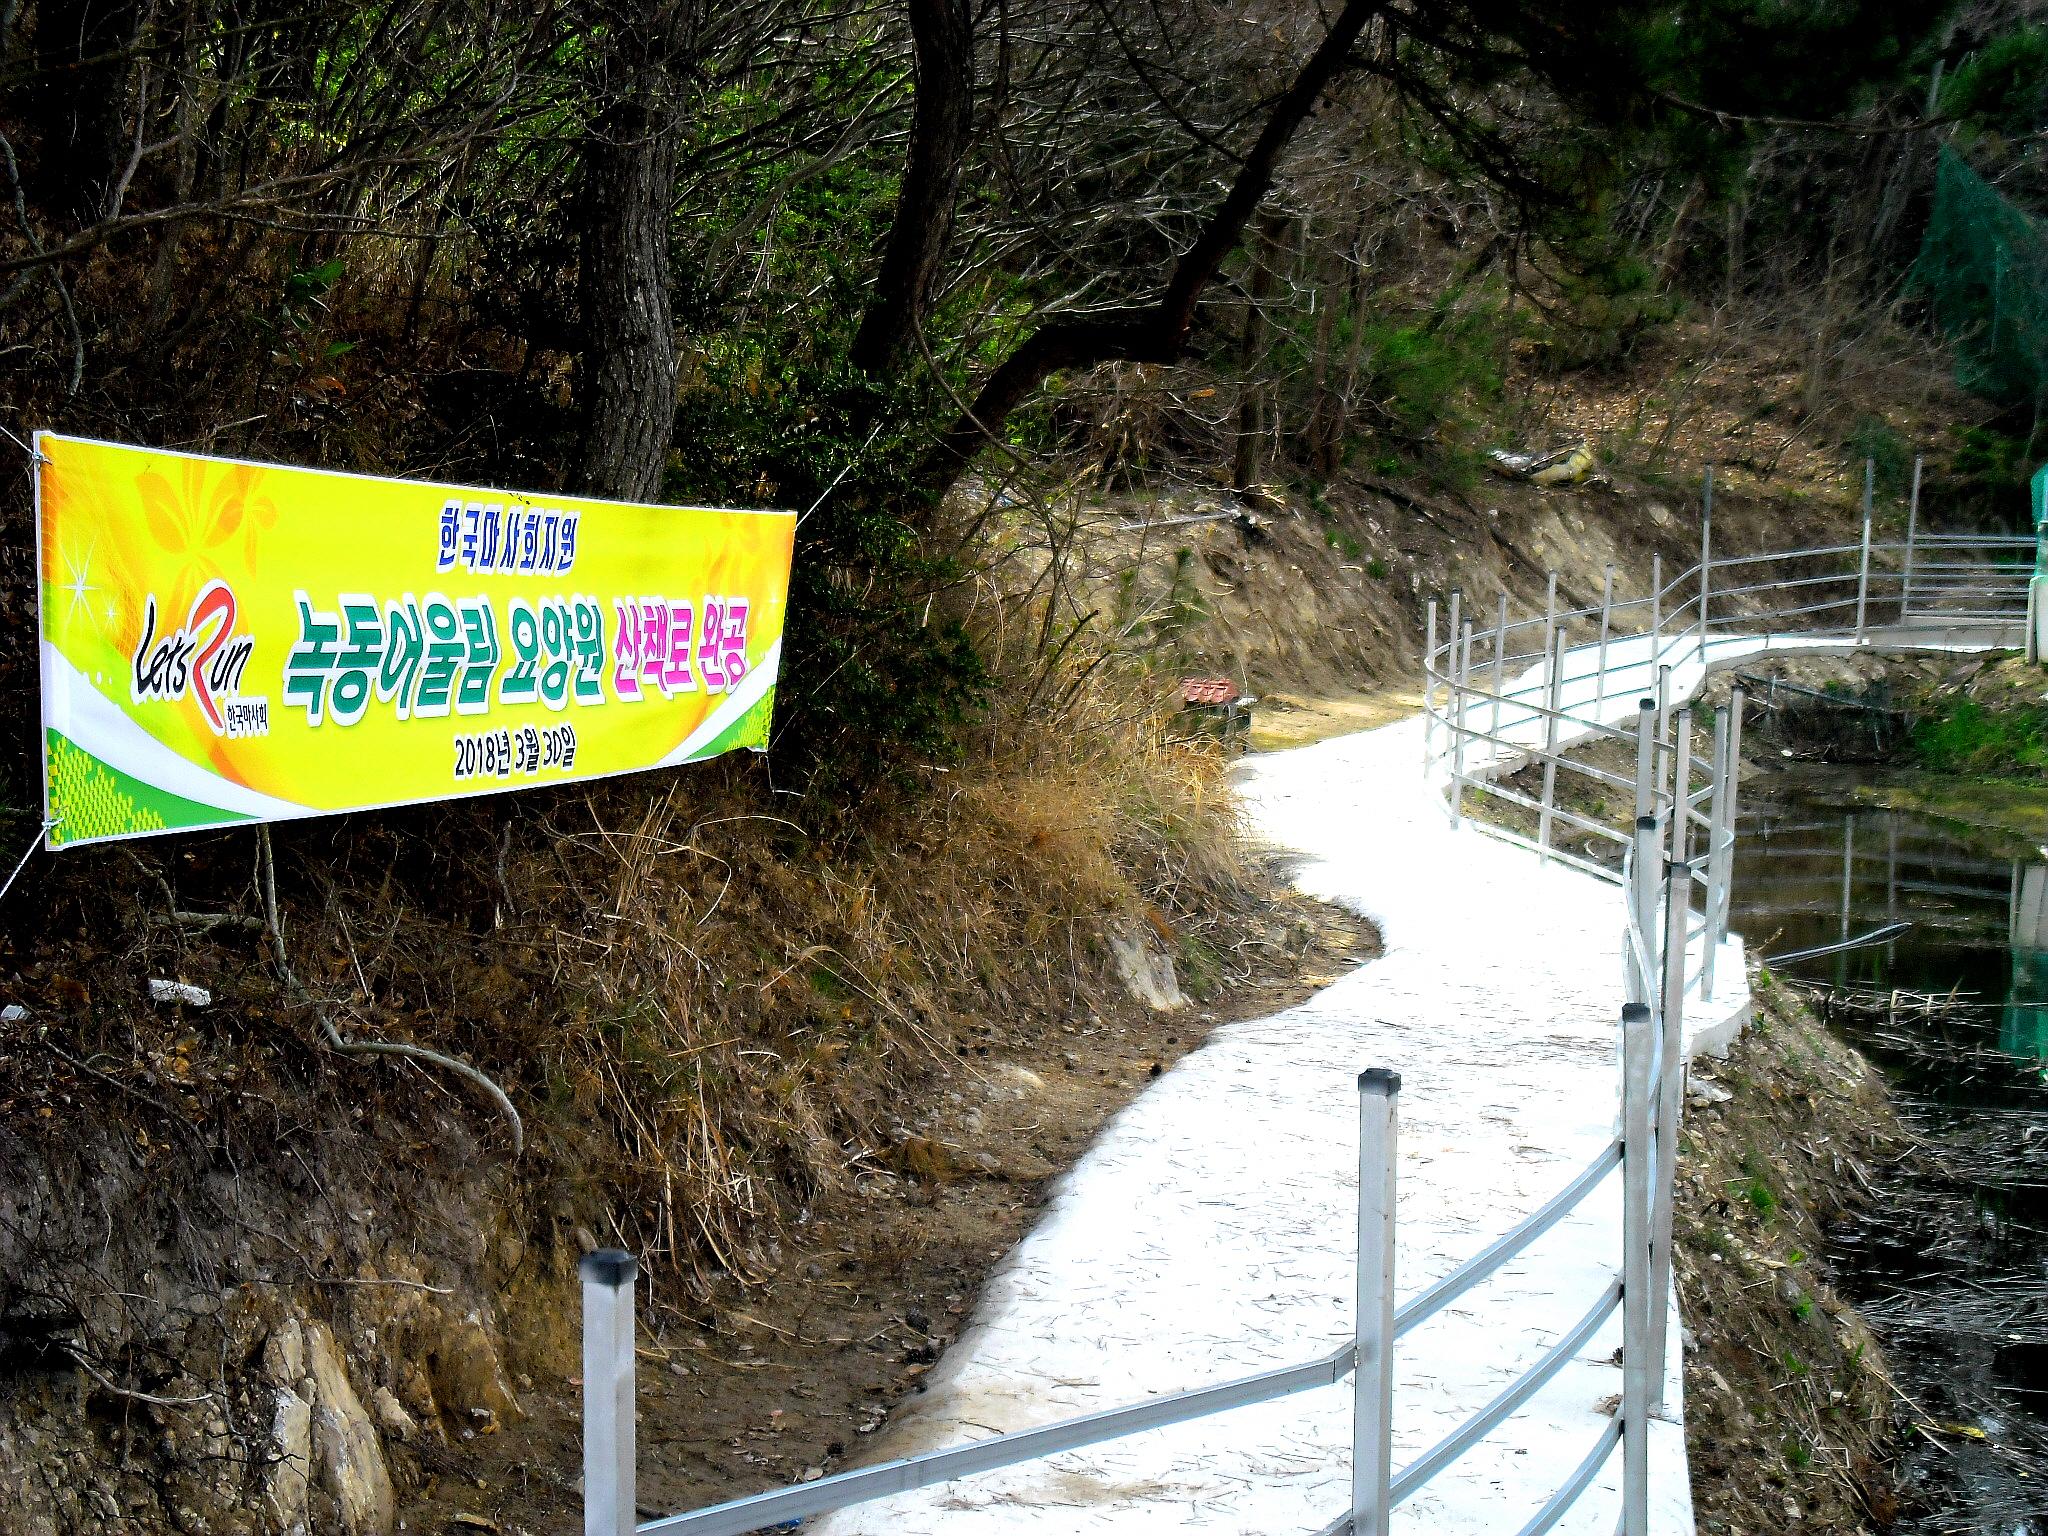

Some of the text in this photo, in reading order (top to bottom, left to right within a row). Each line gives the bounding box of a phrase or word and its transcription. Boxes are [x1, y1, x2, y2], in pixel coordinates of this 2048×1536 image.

[439, 507, 577, 570] 한국마사회지원
[289, 601, 748, 714] 녹동어울림 요양원 산책로 완공
[227, 703, 268, 731] 한국마사회
[455, 725, 576, 775] 2018년 3월 30일
